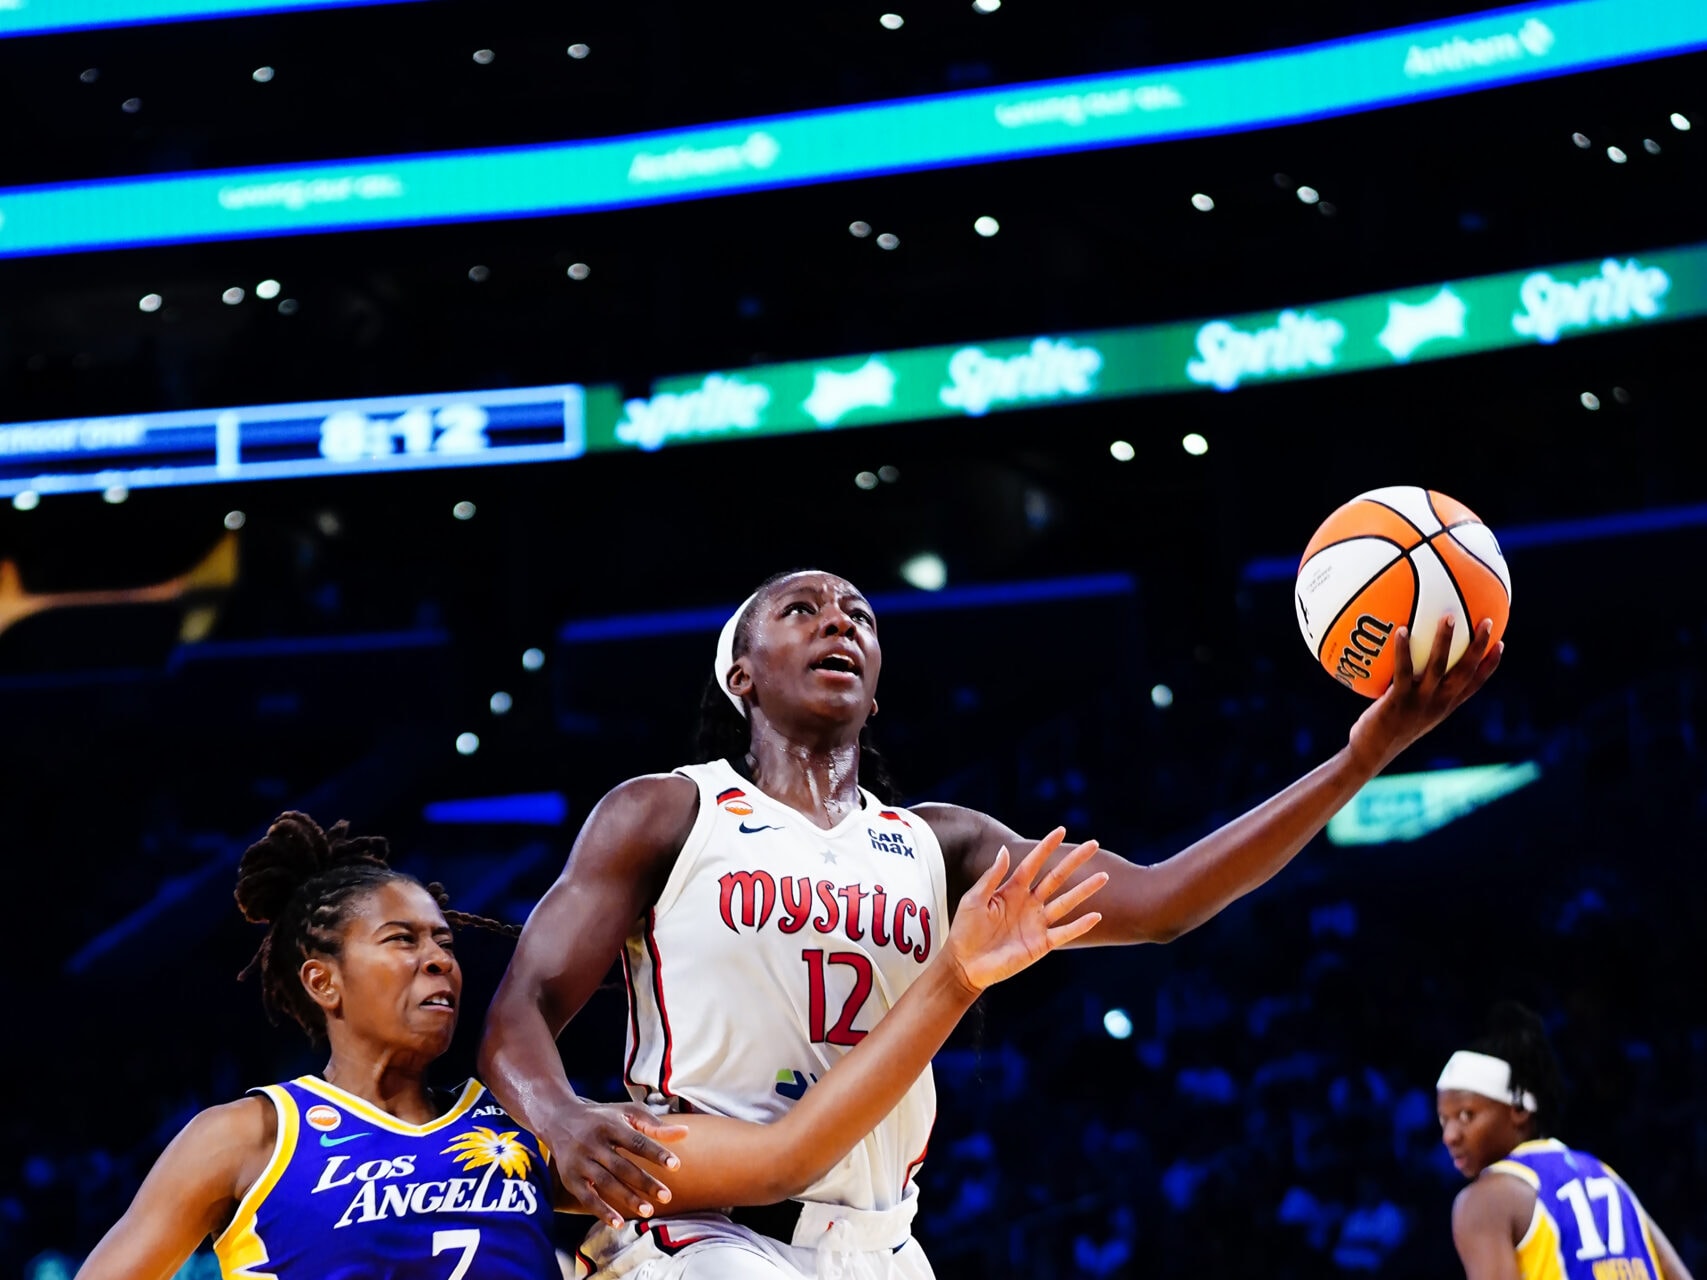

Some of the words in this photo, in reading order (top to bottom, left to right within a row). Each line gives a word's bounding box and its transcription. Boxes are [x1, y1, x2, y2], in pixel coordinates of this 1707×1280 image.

[1511, 258, 1671, 344] Sprite
[939, 337, 1103, 416] Sprite
[1186, 308, 1345, 392] Sprite
[867, 828, 905, 845] CAR
[802, 949, 873, 1046] 12
[1556, 1176, 1625, 1261] 17
